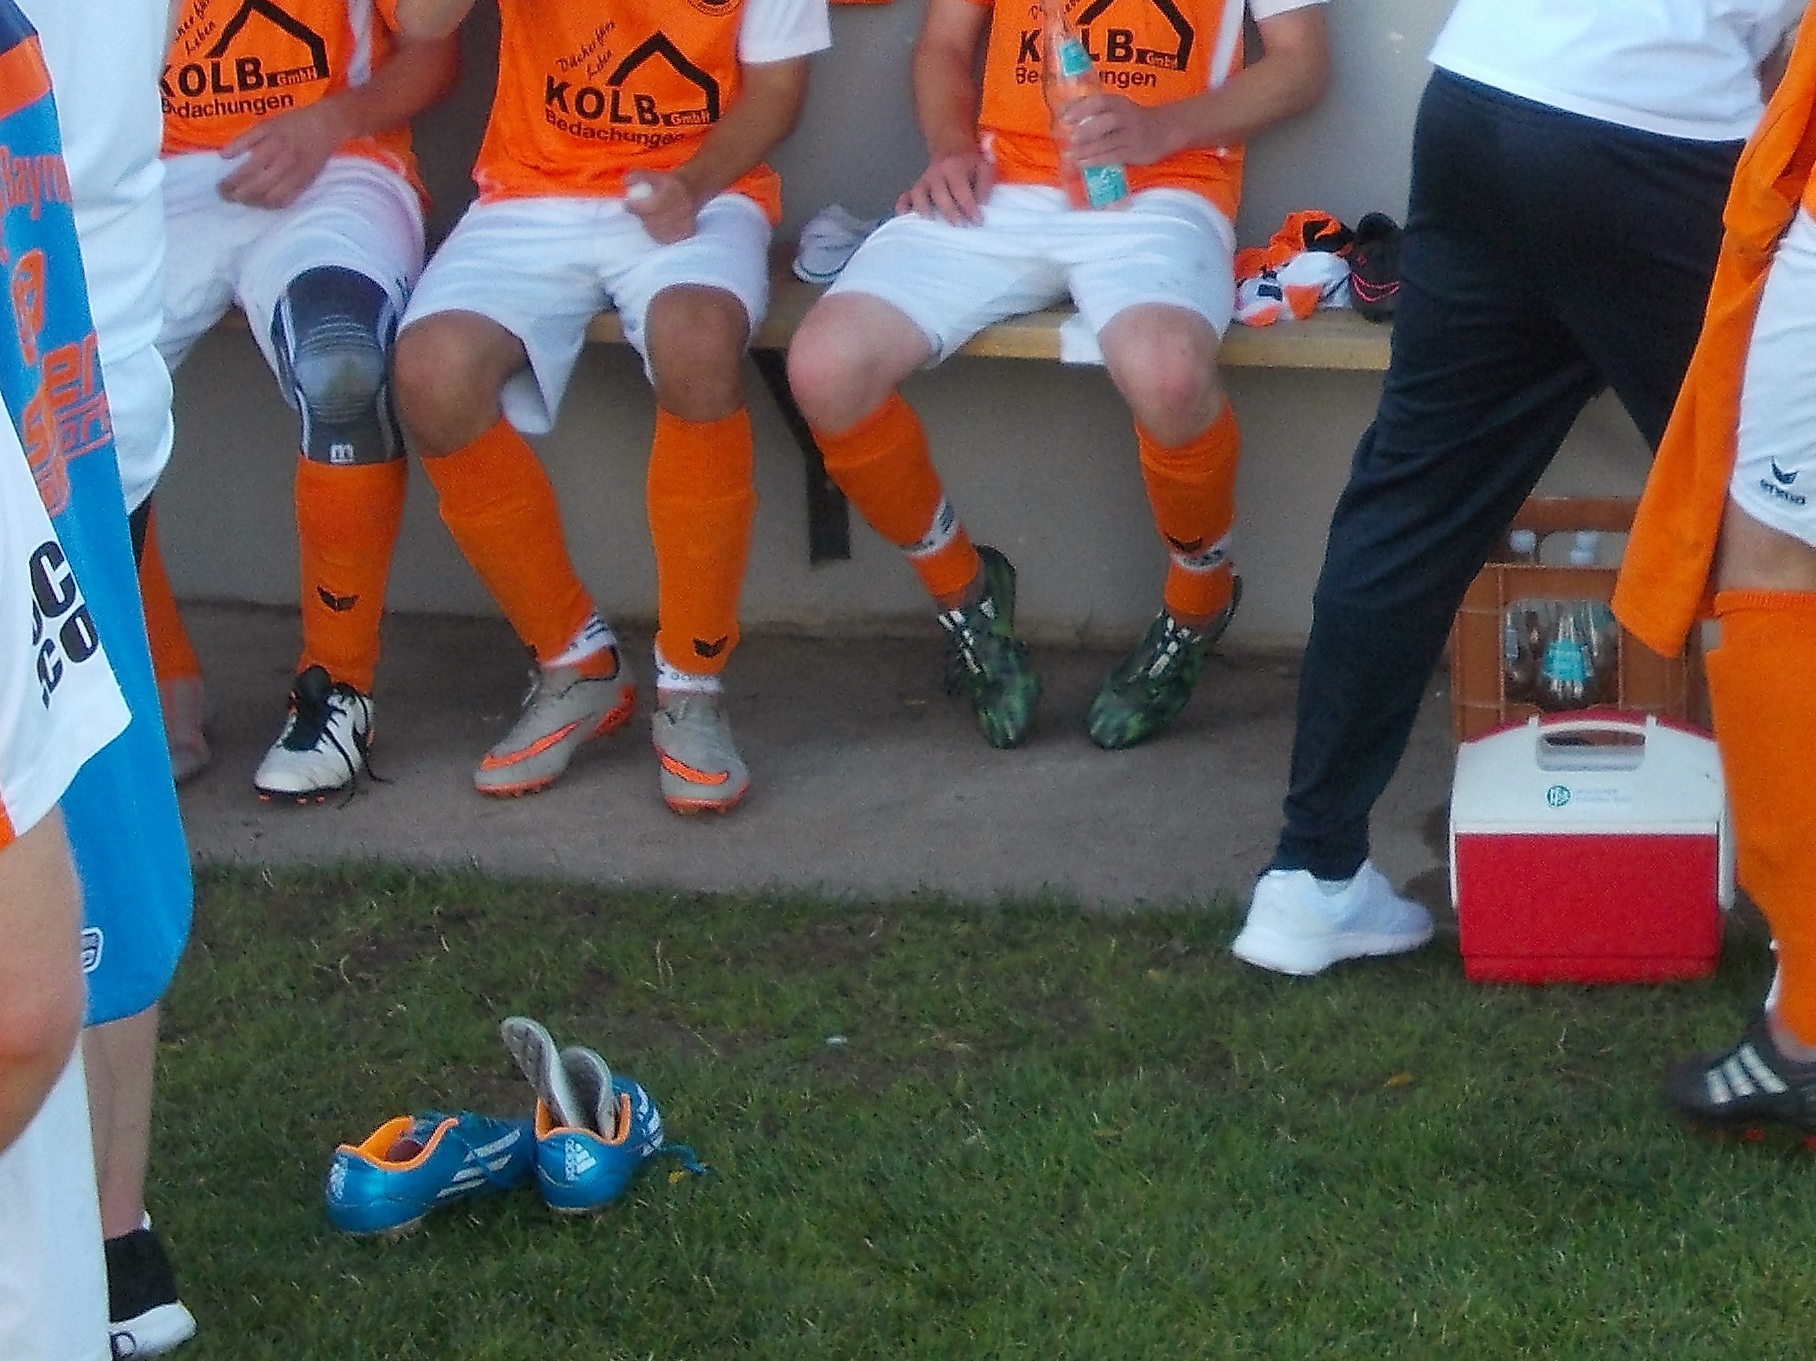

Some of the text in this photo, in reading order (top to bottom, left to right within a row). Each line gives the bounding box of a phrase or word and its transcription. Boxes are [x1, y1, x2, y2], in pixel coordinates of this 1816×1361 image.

[1017, 28, 1134, 64] KLB
[1015, 67, 1157, 89] Bengen
[545, 74, 660, 126] KOLB
